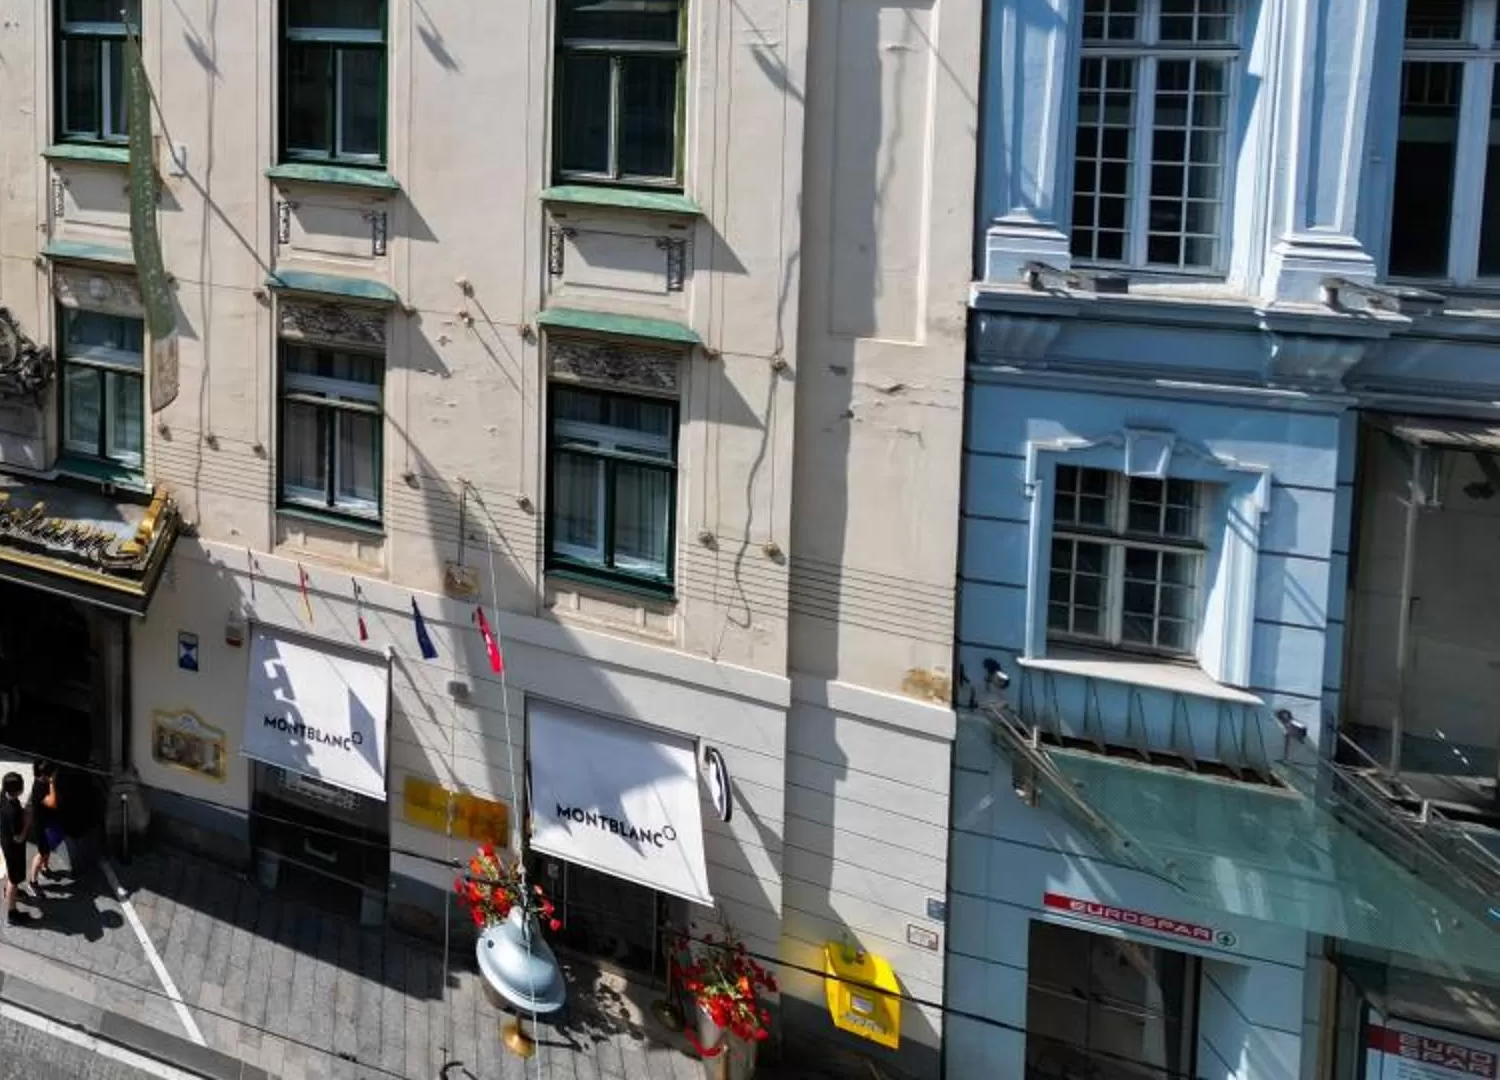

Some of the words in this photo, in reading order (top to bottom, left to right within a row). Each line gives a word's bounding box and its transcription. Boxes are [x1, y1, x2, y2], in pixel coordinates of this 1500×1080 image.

[263, 715, 351, 751] MONTBLANC
[556, 802, 664, 849] MONTBLANC
[1069, 900, 1210, 940] EUROSPAR
